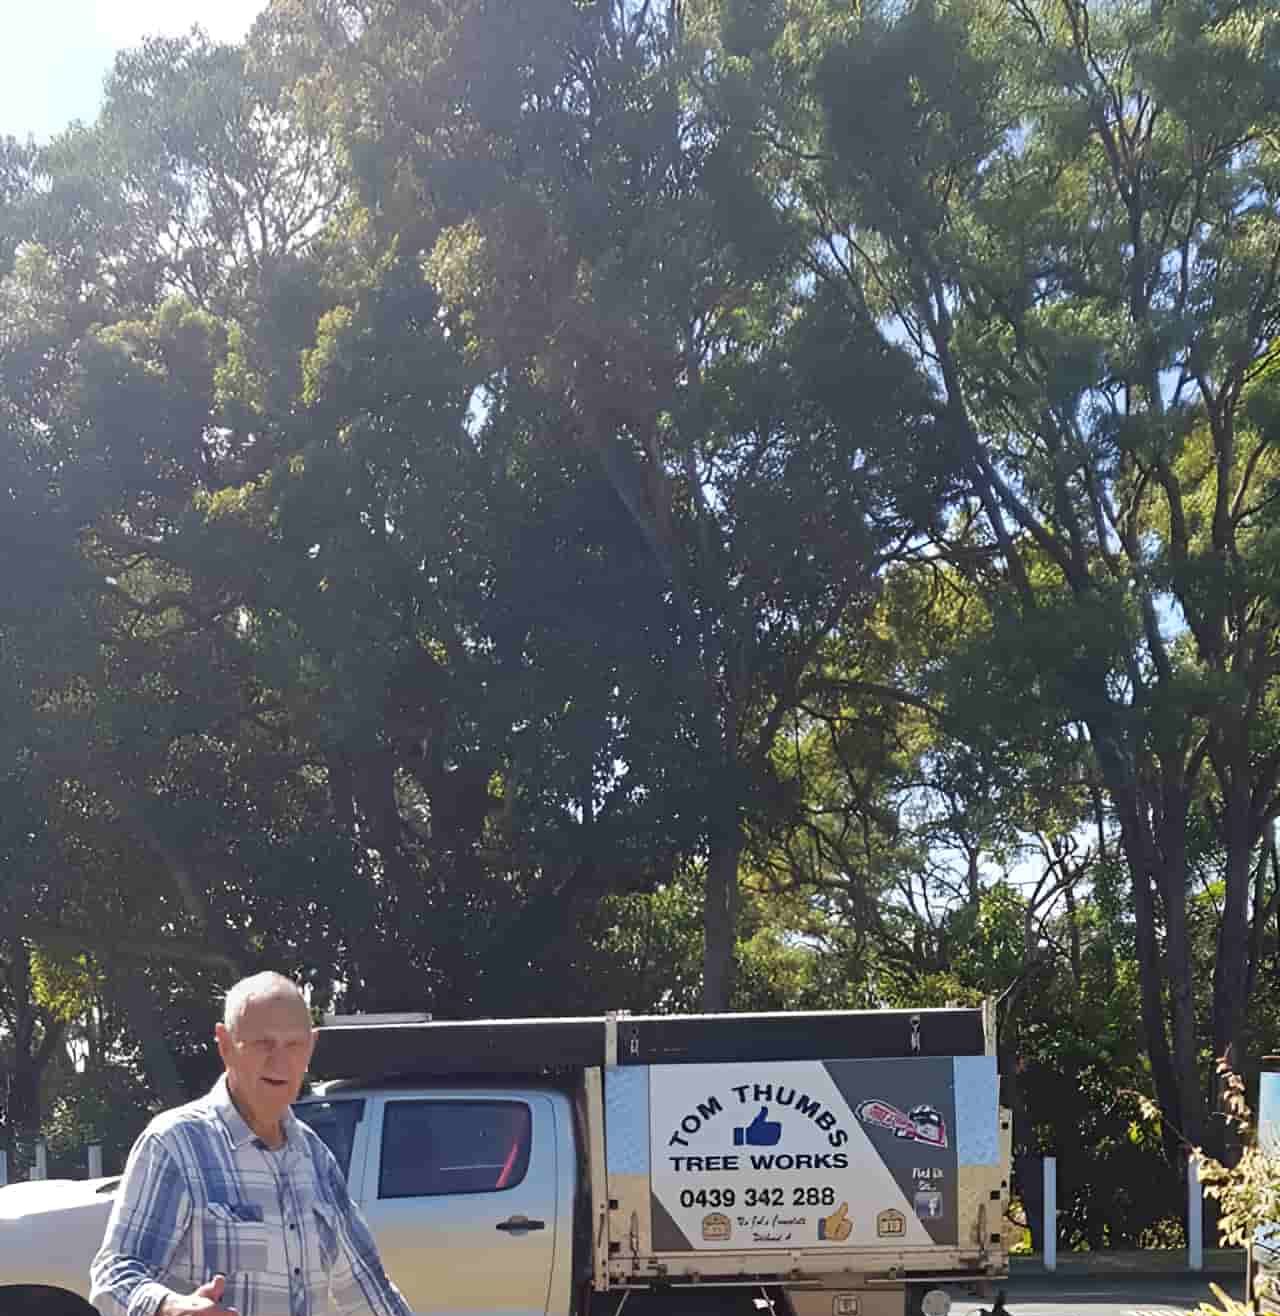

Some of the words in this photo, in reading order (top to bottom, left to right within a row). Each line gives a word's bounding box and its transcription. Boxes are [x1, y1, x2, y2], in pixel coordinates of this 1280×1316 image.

[669, 1096, 723, 1147] TOM
[731, 1084, 848, 1147] THUMBS
[669, 1156, 739, 1171] TREE
[751, 1153, 848, 1170] WORKS
[680, 1189, 736, 1208] 0439
[745, 1188, 784, 1207] 342
[793, 1187, 835, 1206] 288
